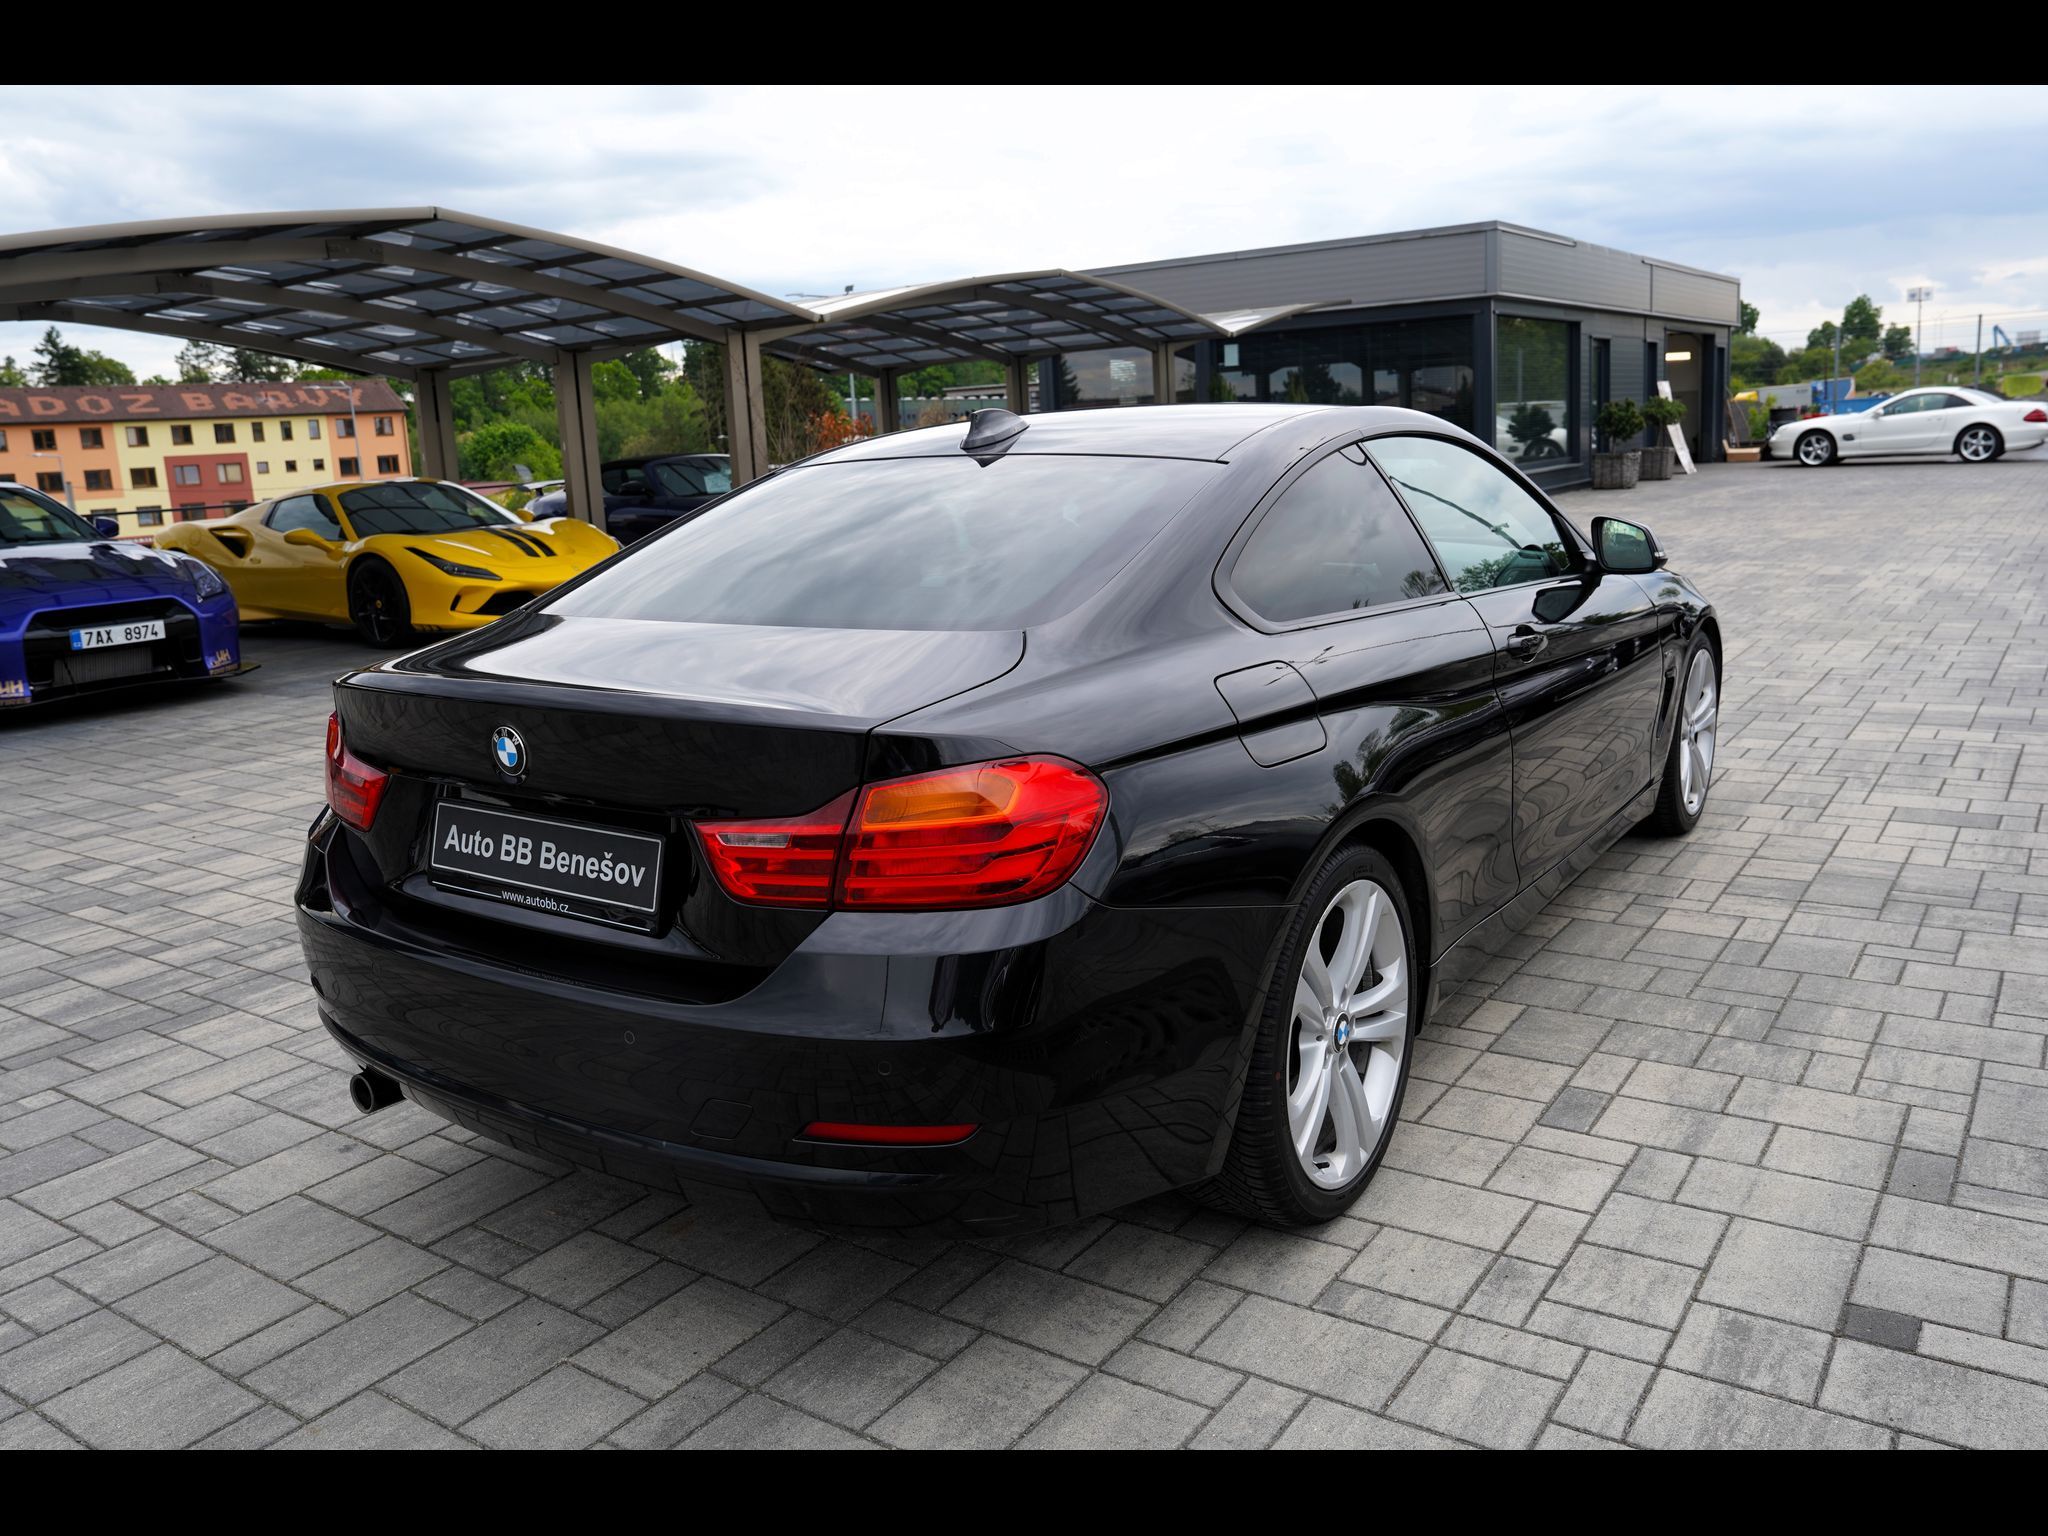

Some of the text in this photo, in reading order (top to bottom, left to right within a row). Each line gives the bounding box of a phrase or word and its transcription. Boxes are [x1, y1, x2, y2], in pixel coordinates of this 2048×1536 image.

[85, 624, 158, 646] 7AX 8974
[493, 728, 520, 746] BMW
[444, 824, 646, 887] Auto BB Benešov
[501, 889, 569, 914] www.autobb.cz
